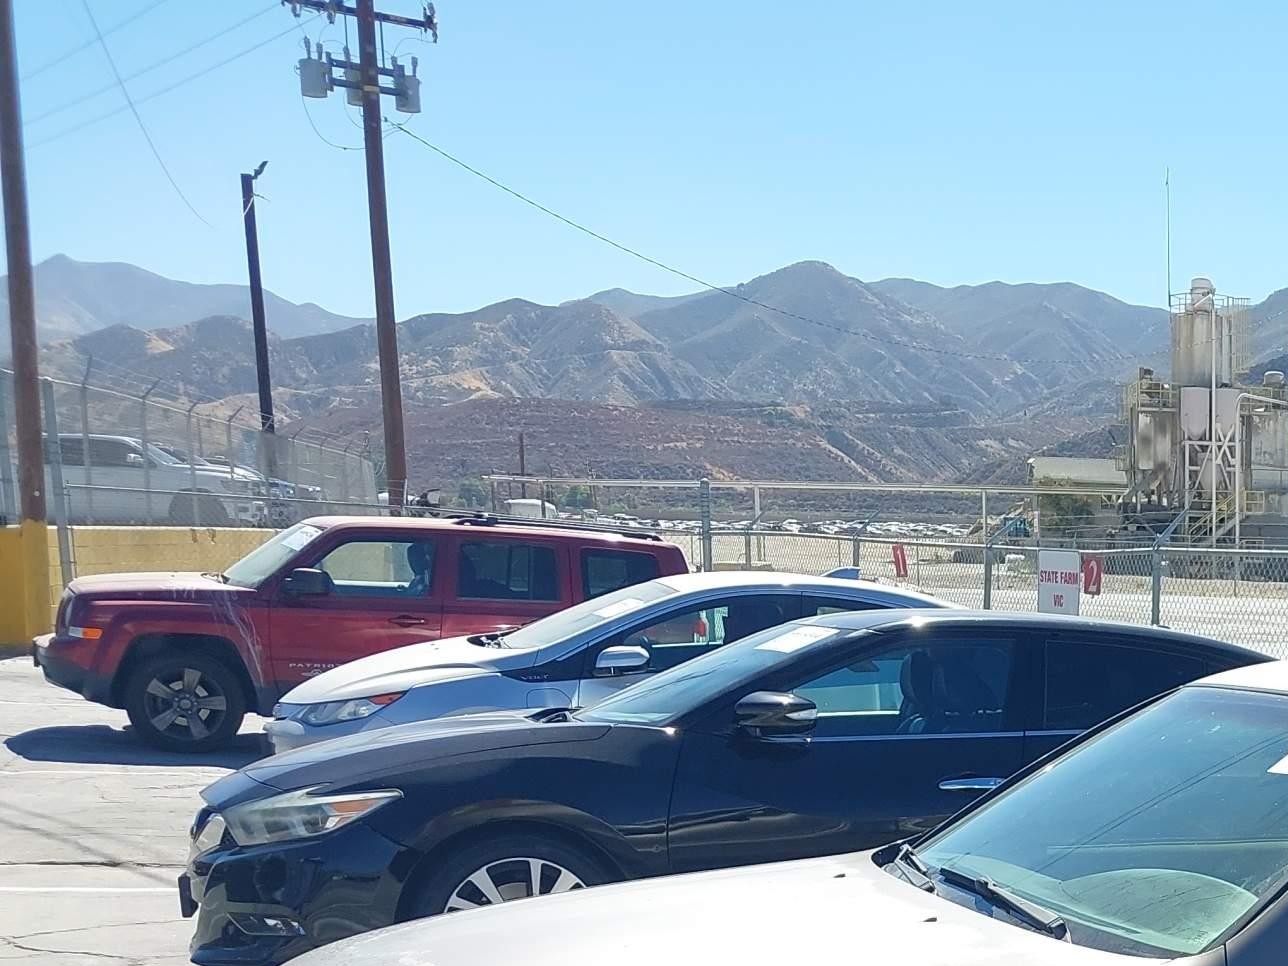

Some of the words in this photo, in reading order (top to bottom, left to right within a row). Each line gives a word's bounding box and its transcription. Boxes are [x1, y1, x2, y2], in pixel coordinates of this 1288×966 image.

[1040, 570, 1059, 583] STATE
[1060, 571, 1078, 585] FARM
[1088, 560, 1098, 592] 2
[1053, 594, 1064, 607] VIC
